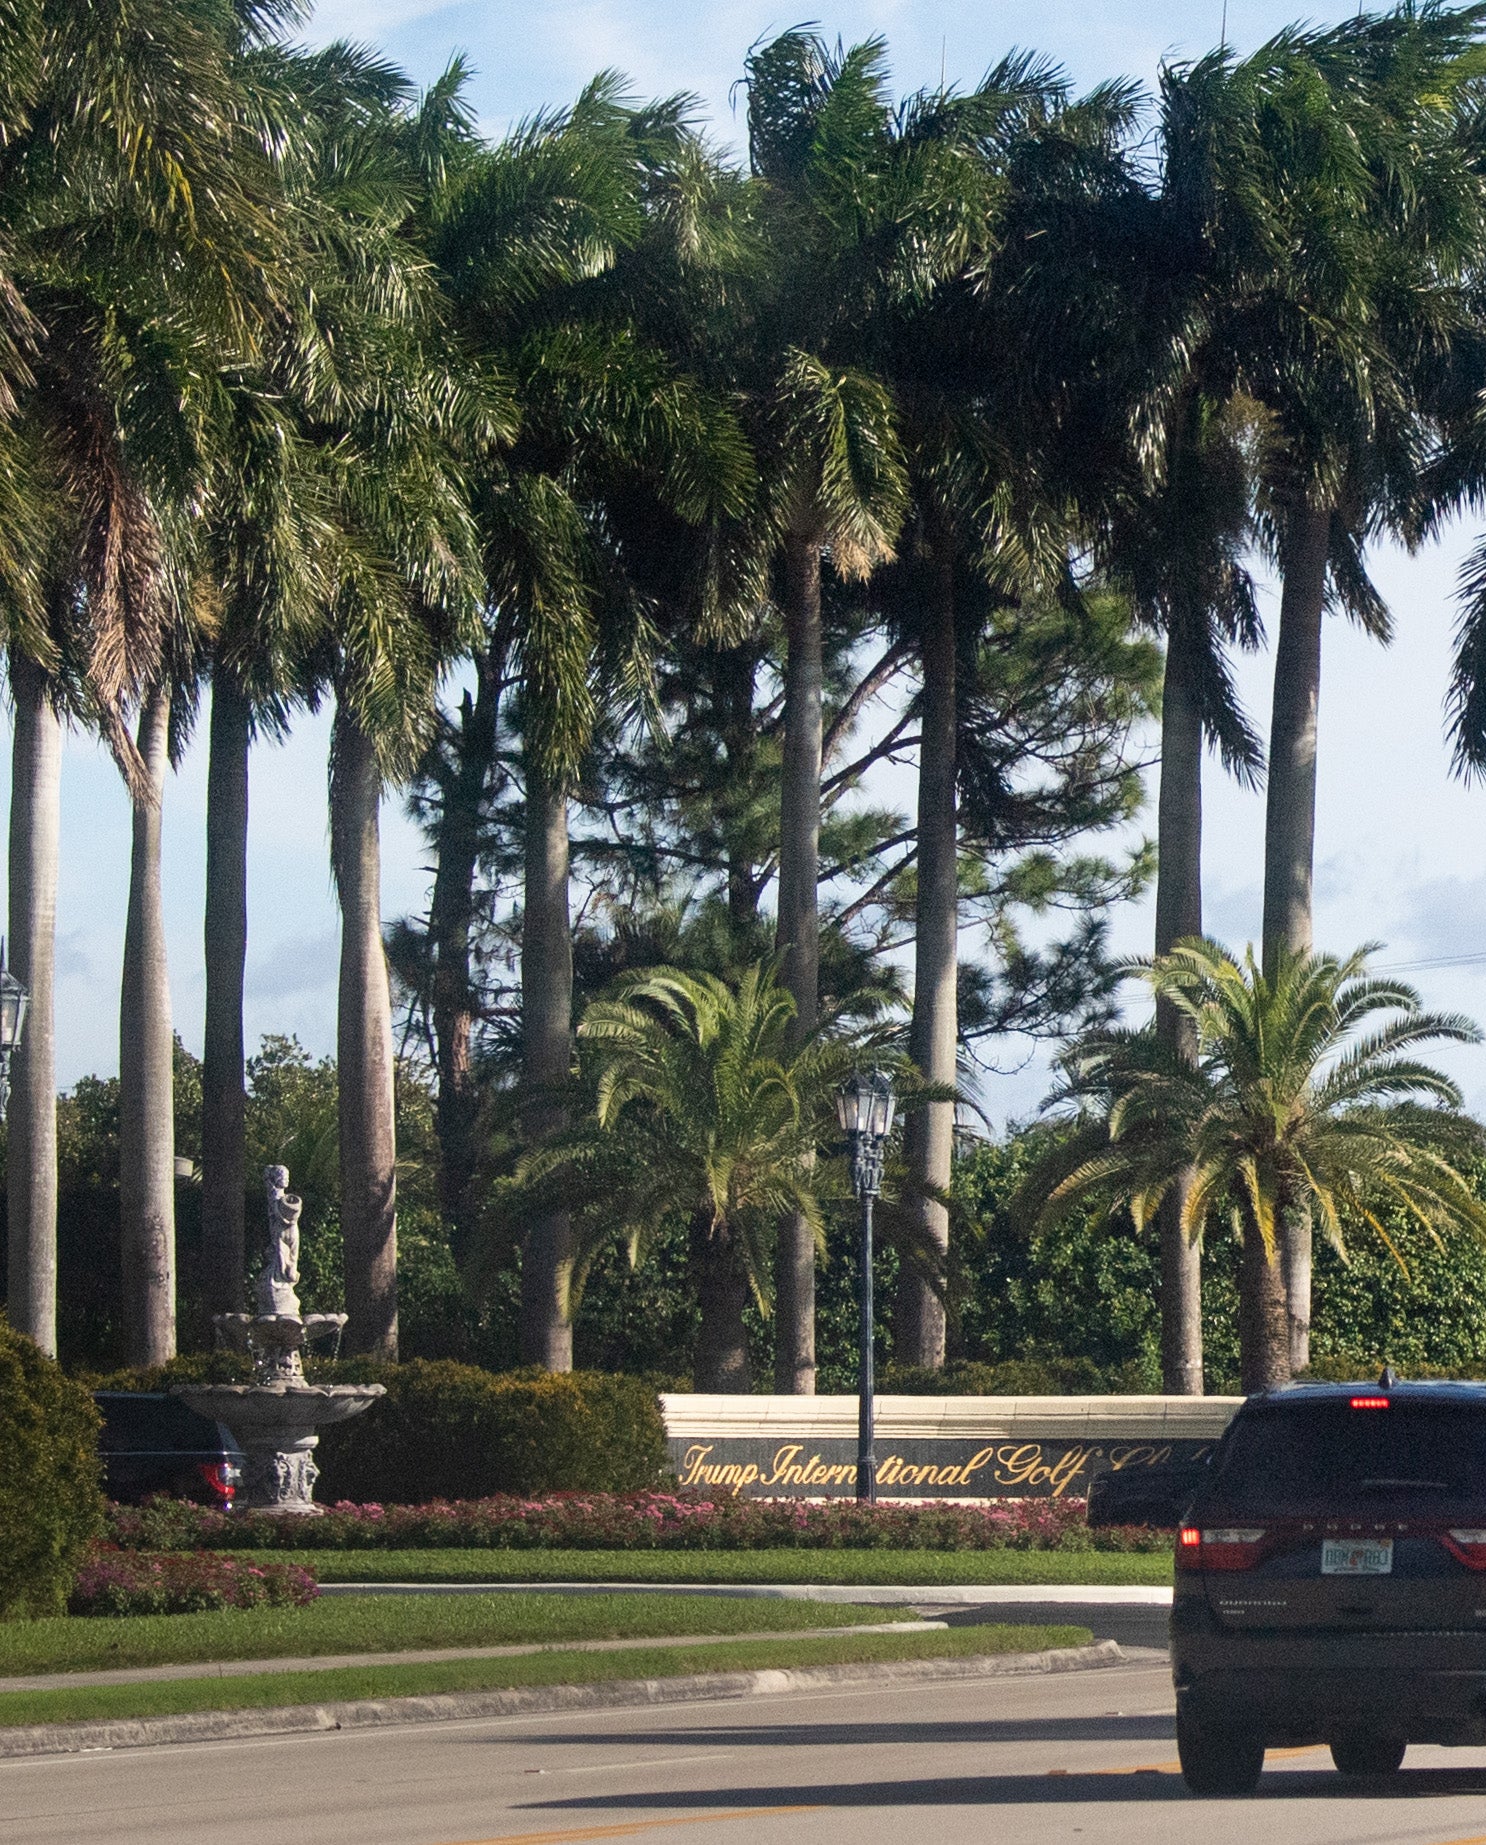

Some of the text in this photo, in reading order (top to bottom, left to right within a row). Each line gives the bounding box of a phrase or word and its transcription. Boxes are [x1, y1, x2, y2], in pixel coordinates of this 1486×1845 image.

[678, 1444, 759, 1497] Trump
[760, 1445, 994, 1486] Interntional
[994, 1444, 1104, 1498] Golf
